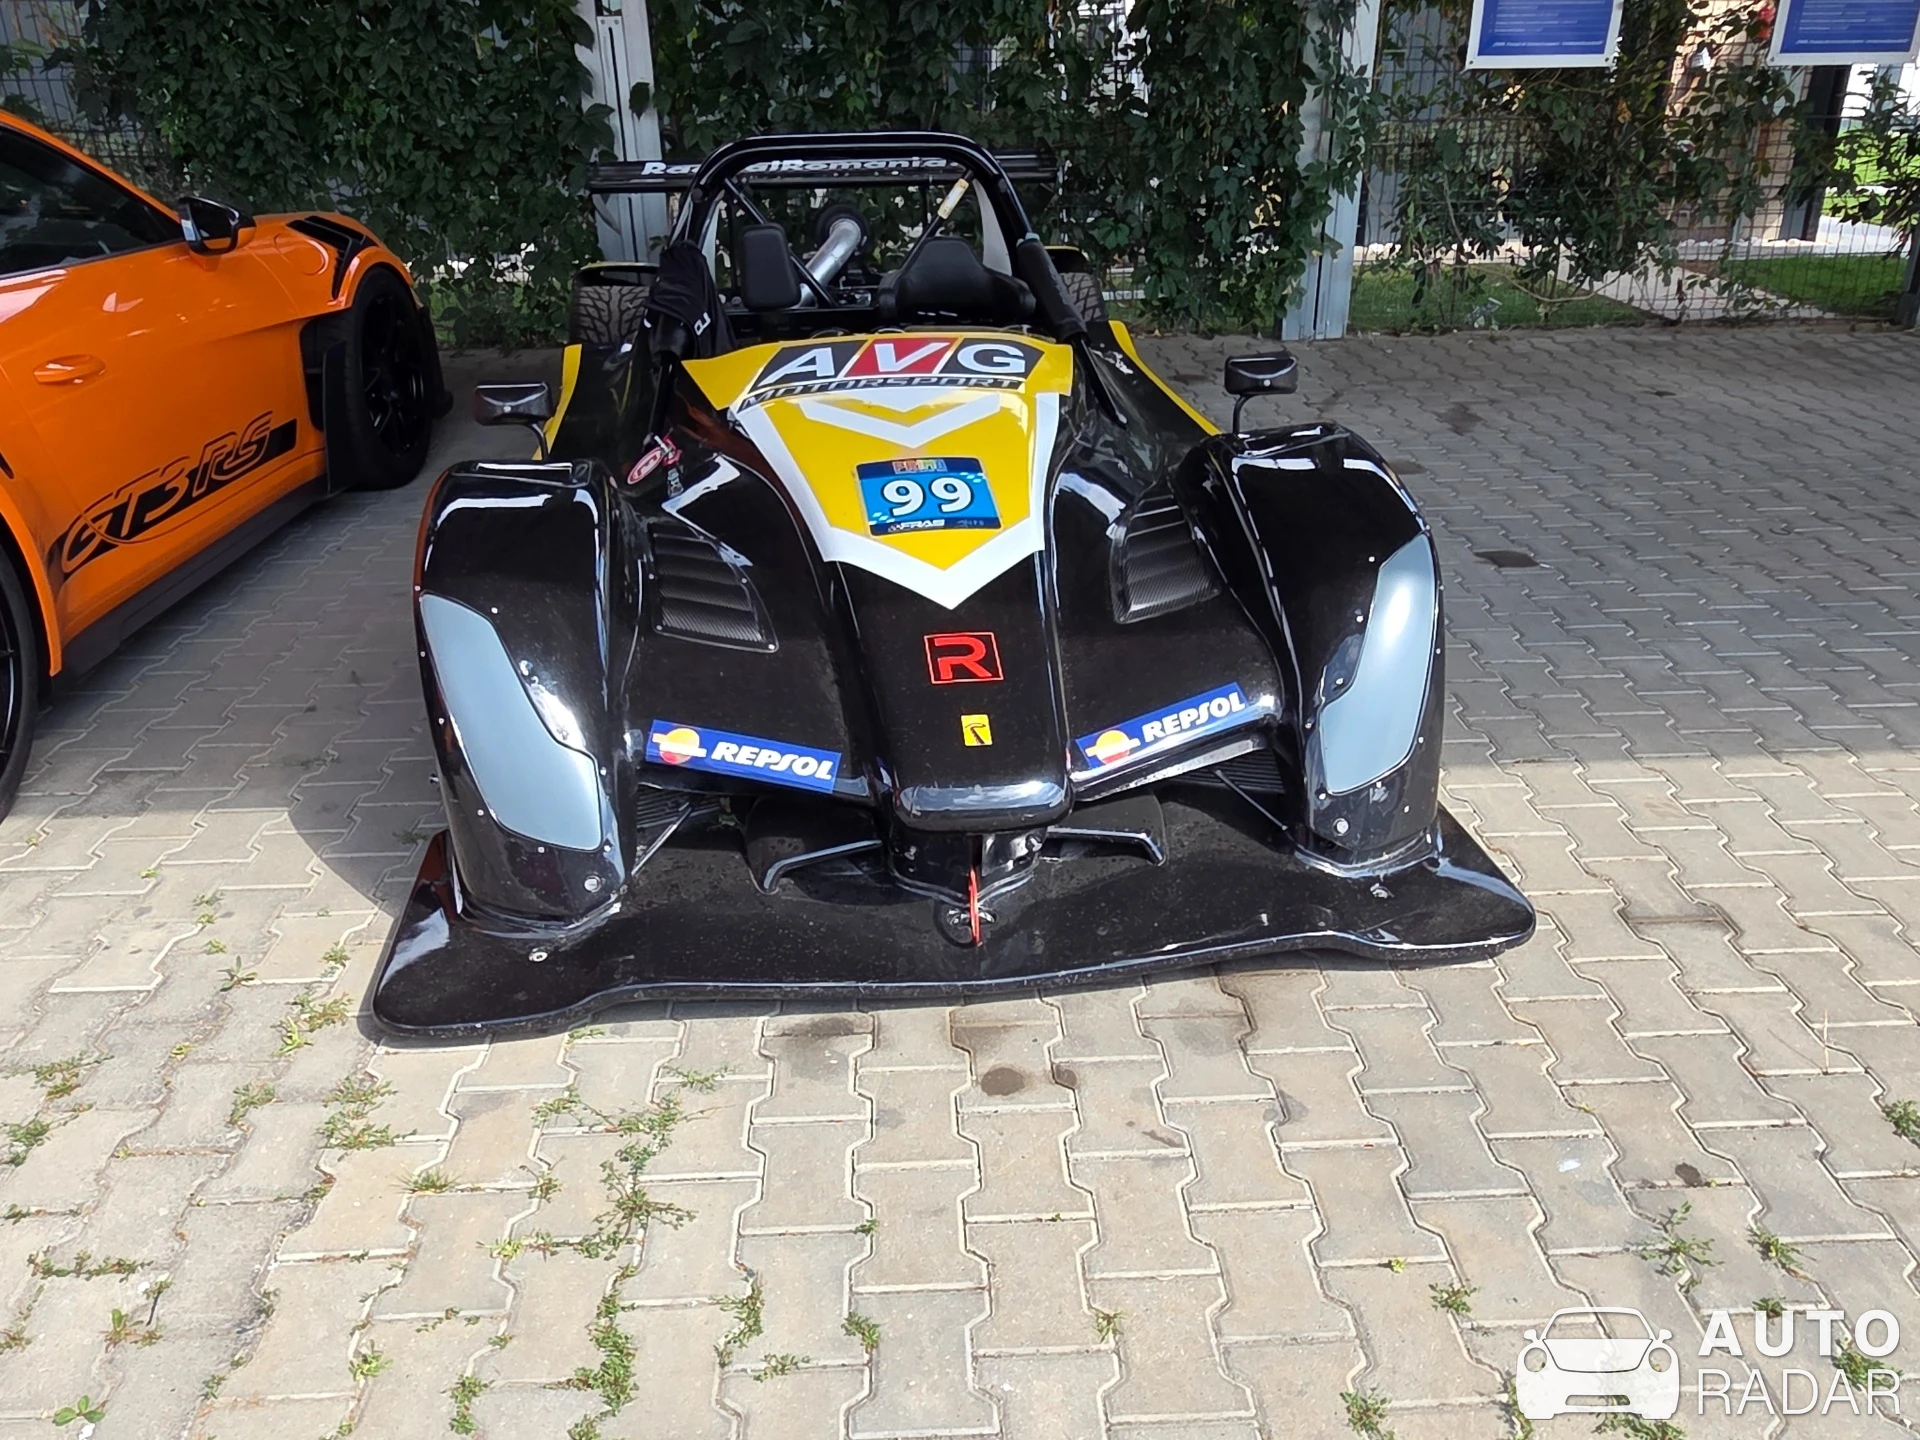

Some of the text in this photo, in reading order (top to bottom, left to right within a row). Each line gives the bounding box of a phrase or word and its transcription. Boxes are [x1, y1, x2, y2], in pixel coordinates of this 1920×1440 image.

[757, 343, 1026, 387] AVG
[741, 376, 1018, 406] MOTORSPORT
[883, 477, 971, 516] 99
[1141, 692, 1246, 743] REPSOL
[711, 741, 832, 780] REPSOL
